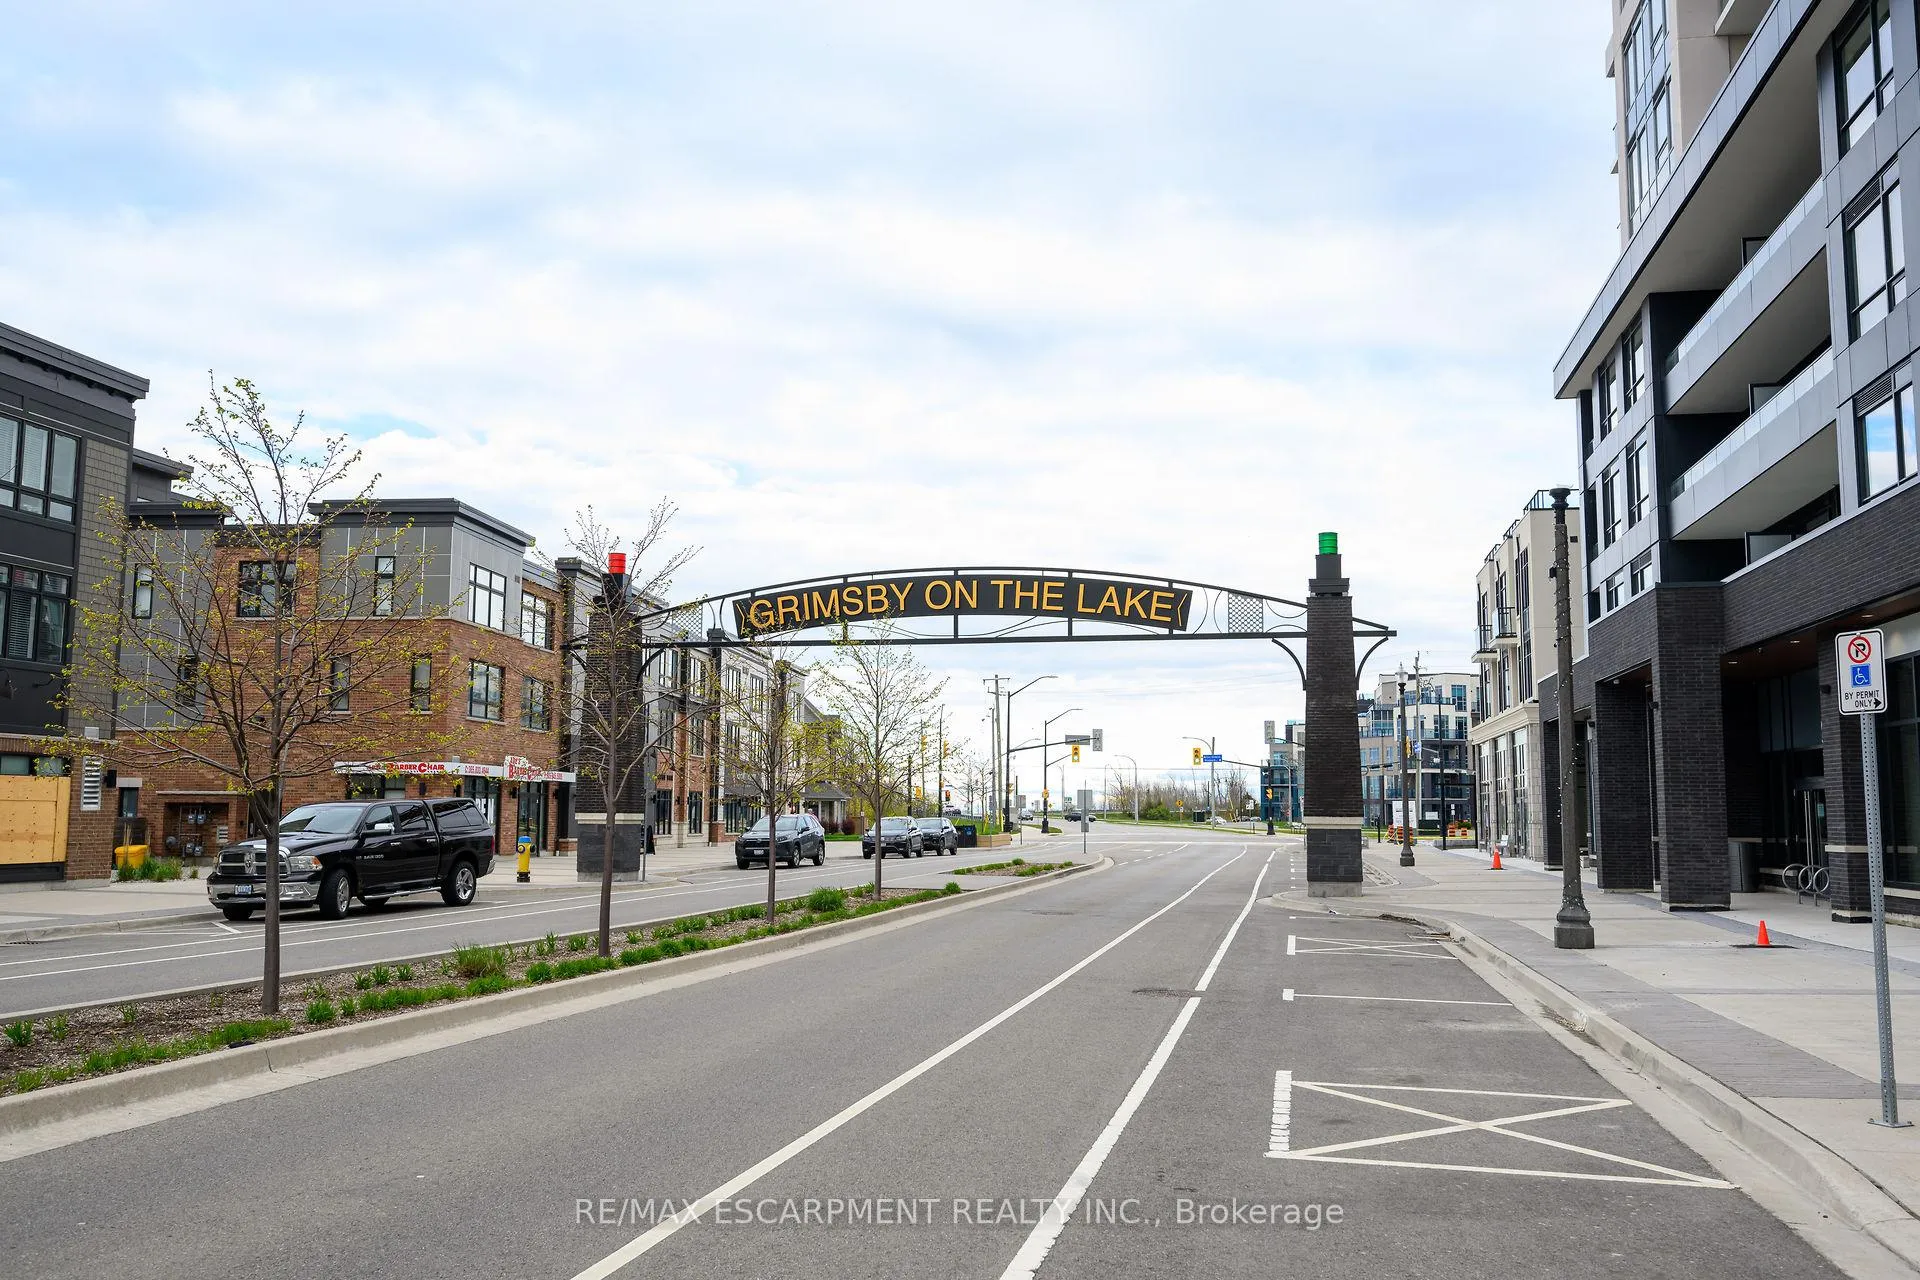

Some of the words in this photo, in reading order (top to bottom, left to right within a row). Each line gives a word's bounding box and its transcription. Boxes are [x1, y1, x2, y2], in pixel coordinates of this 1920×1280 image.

[749, 582, 913, 628] GRIMSBY
[925, 580, 977, 611] ON
[991, 580, 1065, 611] THE
[1077, 584, 1175, 621] LAKE
[1844, 692, 1854, 700] BY
[1856, 690, 1880, 699] PERMIT
[1854, 699, 1873, 708] ONLY
[417, 762, 445, 773] CHAIR
